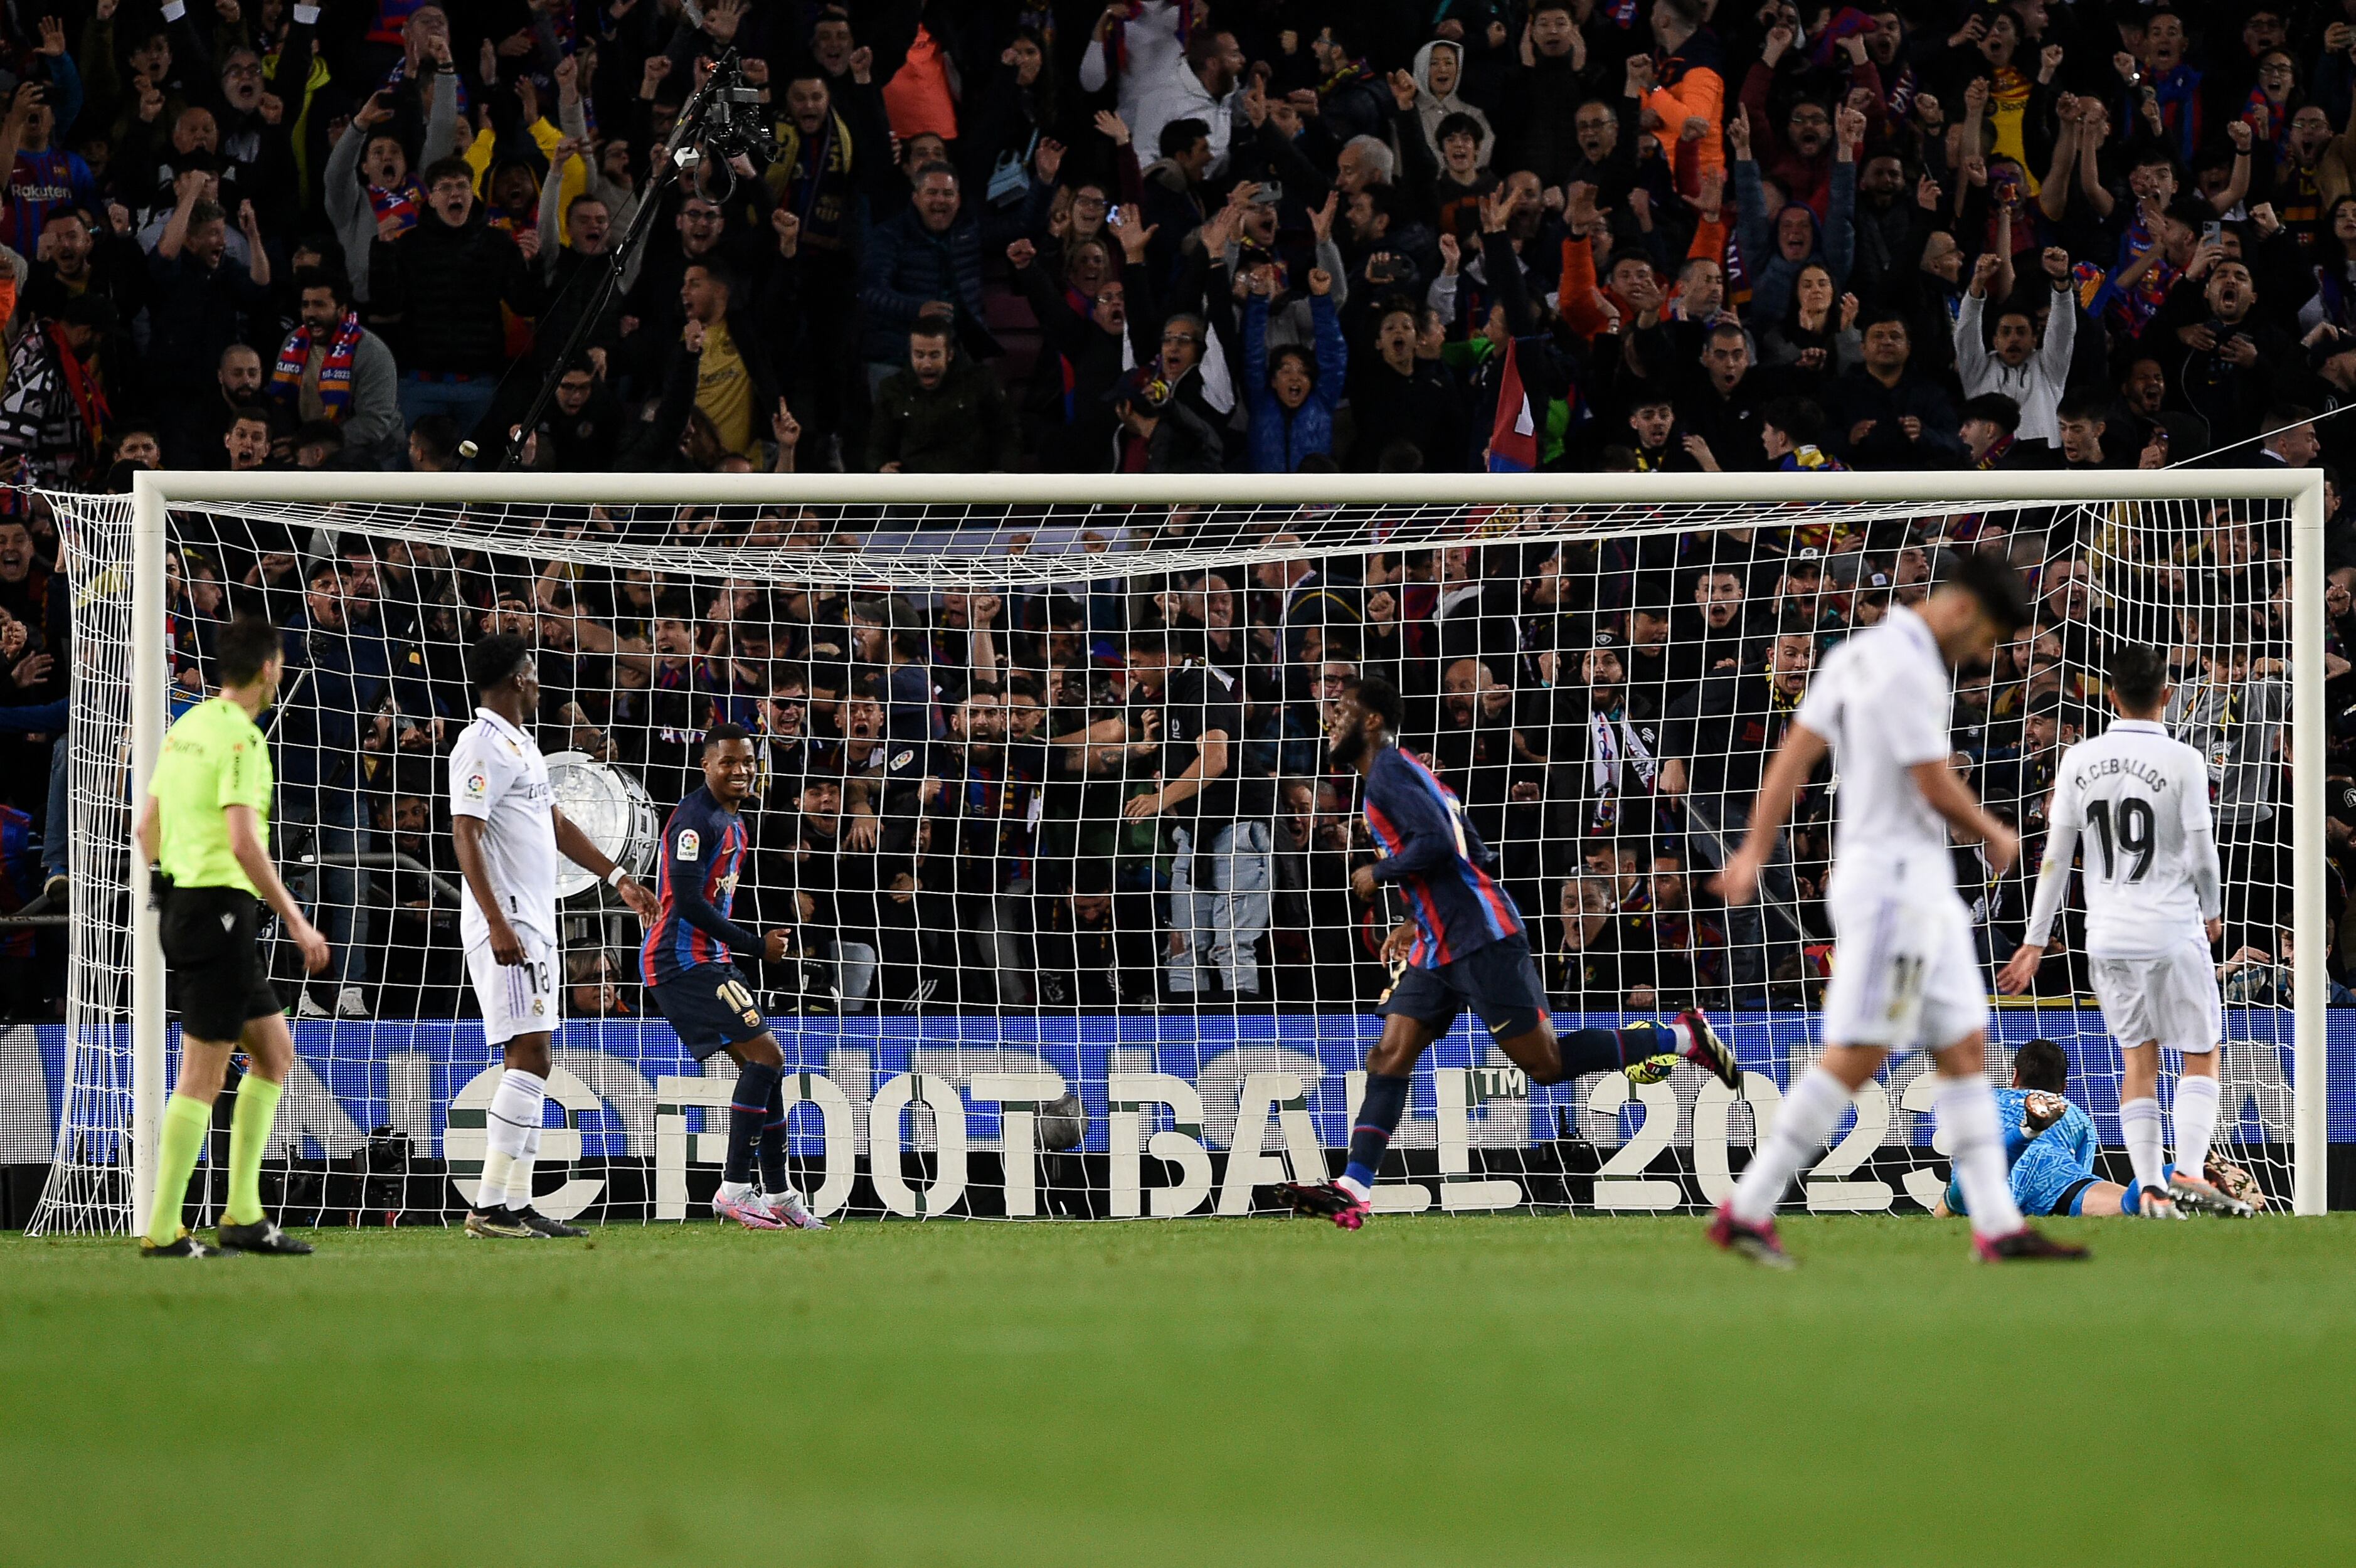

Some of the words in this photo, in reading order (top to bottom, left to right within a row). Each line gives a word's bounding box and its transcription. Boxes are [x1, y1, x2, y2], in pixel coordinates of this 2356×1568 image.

[11, 184, 72, 202] Rakuten
[2086, 797, 2156, 884] 19
[716, 980, 753, 1014] 10
